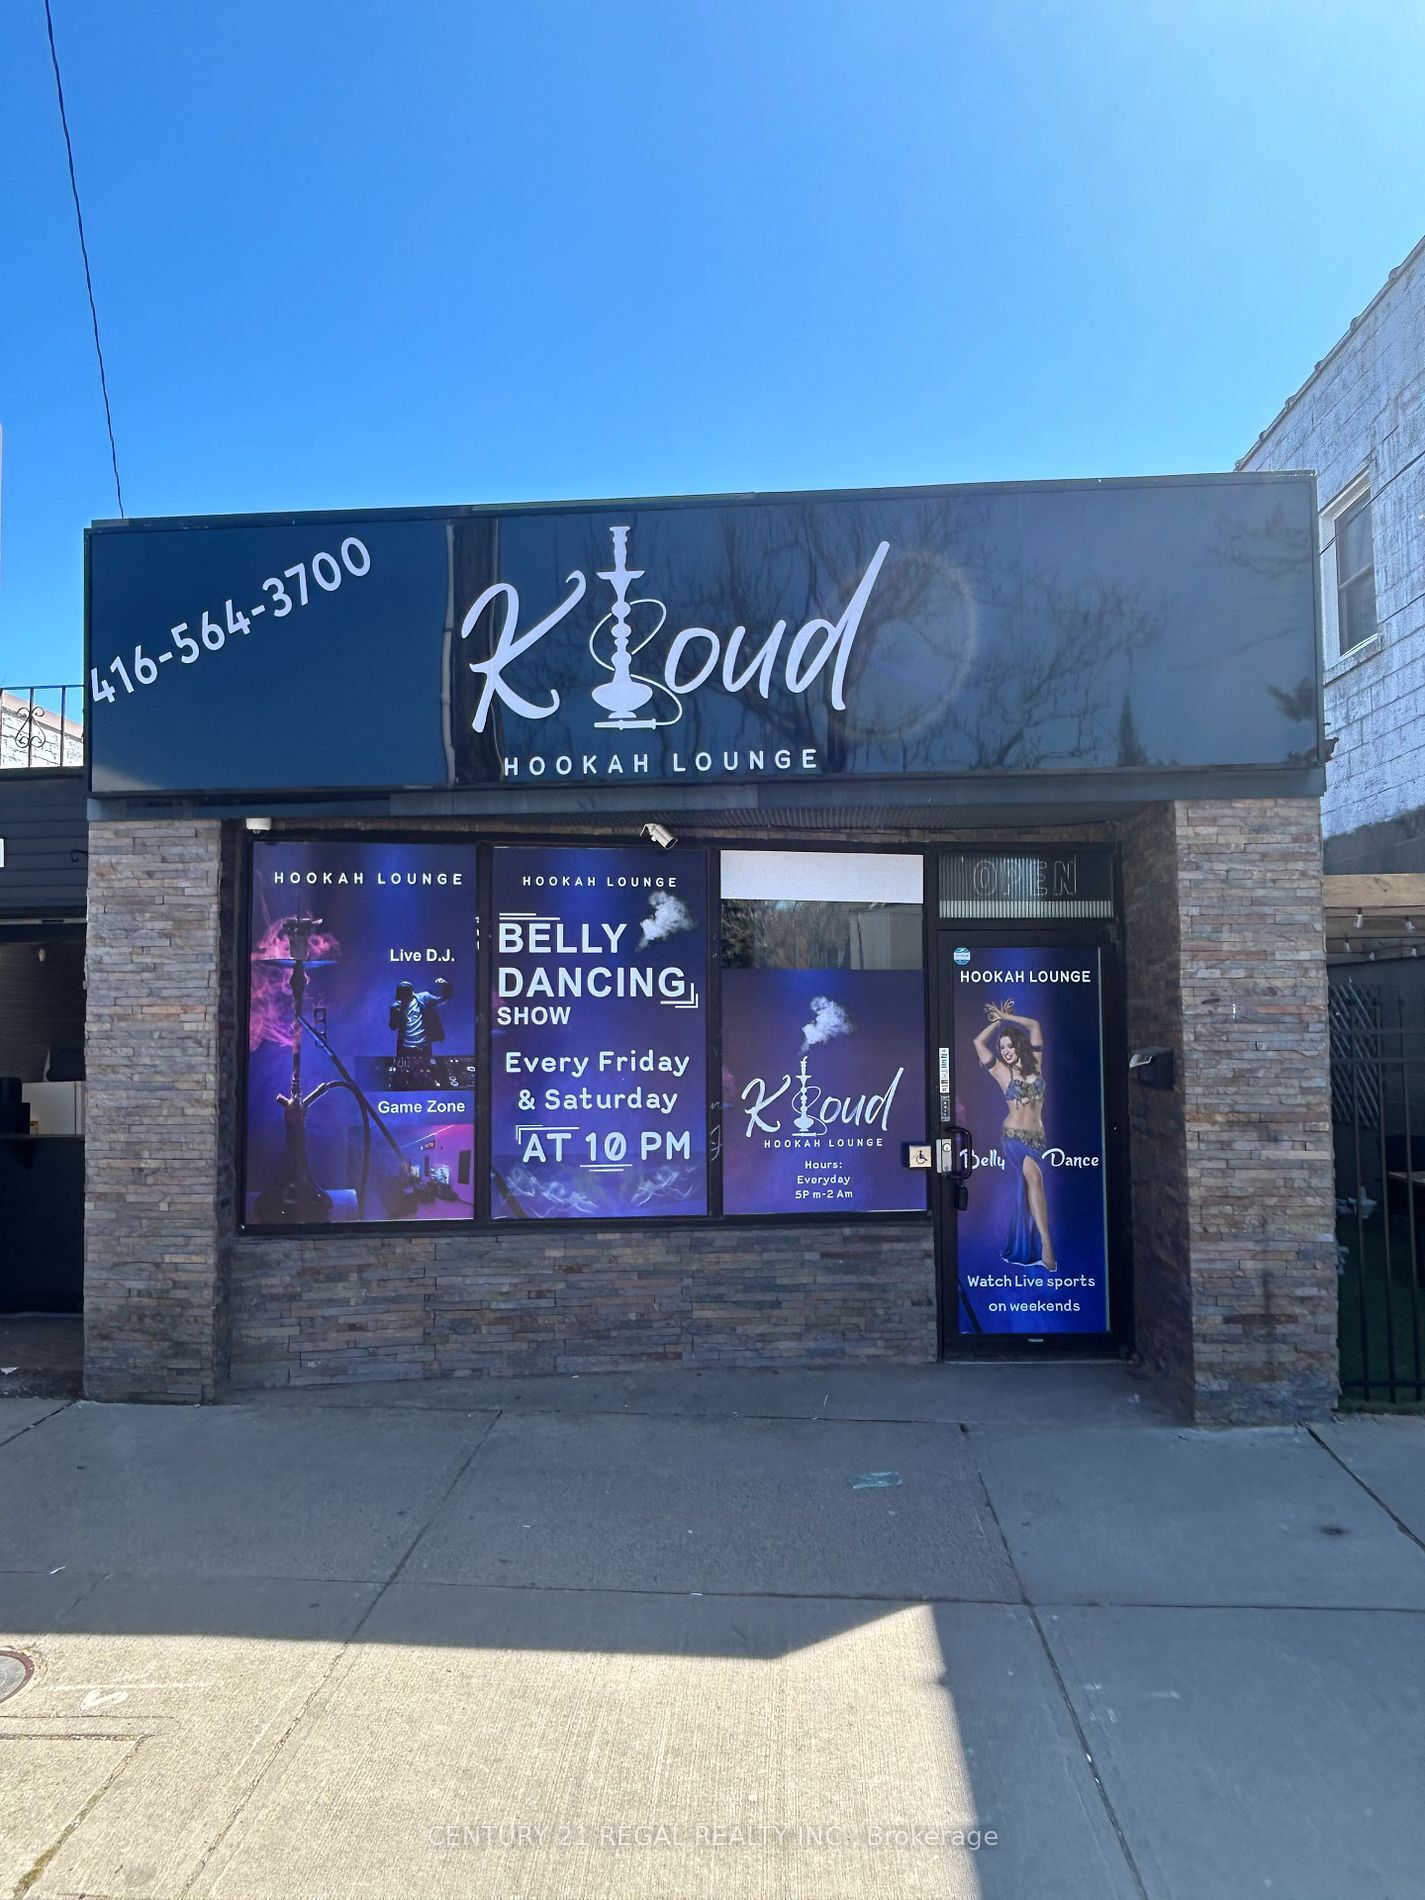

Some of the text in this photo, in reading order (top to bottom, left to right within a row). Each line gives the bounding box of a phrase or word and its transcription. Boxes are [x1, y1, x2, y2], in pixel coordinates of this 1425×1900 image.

[91, 536, 371, 704] 416-564-3700
[504, 749, 817, 776] HOOKAH LOUNGE
[274, 872, 463, 886] HOOKAH LOUNGE
[523, 876, 677, 888] HOOKAH LOUNGE
[498, 923, 628, 954] BELLY
[390, 949, 455, 962] Live D.J.
[498, 967, 686, 998] DANCING
[960, 970, 1092, 983] HOOKAH LOUNGE
[497, 1006, 571, 1025] SHOW
[506, 1049, 690, 1078] Every Friday
[378, 1099, 466, 1114] Game Zone
[518, 1086, 678, 1114] & Saturday
[522, 1130, 691, 1163] AT 10 PM
[764, 1138, 884, 1149] HOOKAH LOUNGE
[804, 1160, 843, 1170] Hours:
[1041, 1147, 1100, 1169] Dance
[797, 1175, 851, 1186] Everyday
[967, 1274, 1096, 1290] Watch Live sports
[988, 1299, 1081, 1312] on weekends
